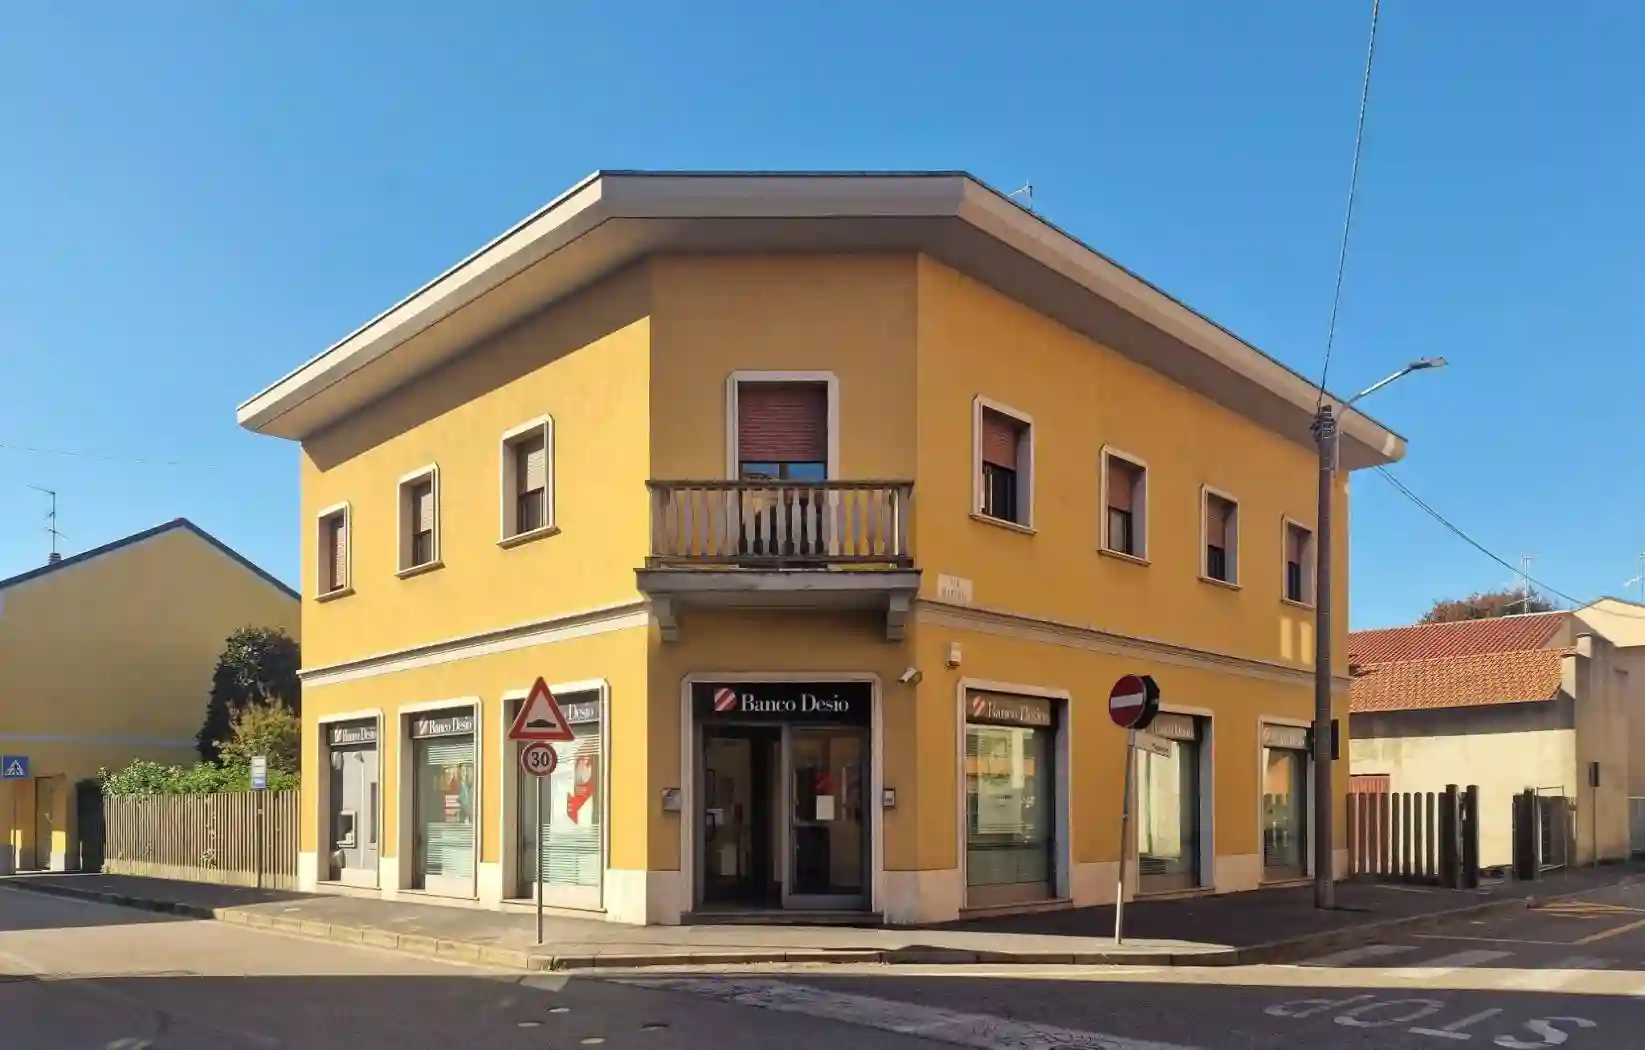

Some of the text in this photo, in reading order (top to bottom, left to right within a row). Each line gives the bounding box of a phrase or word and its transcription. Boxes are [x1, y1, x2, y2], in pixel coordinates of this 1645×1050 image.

[741, 693, 850, 712] Banco Desio
[988, 701, 1045, 721] Banco Desio
[429, 716, 473, 734] Banco Desio
[531, 751, 550, 768] 30
[1264, 994, 1597, 1049] STOP
